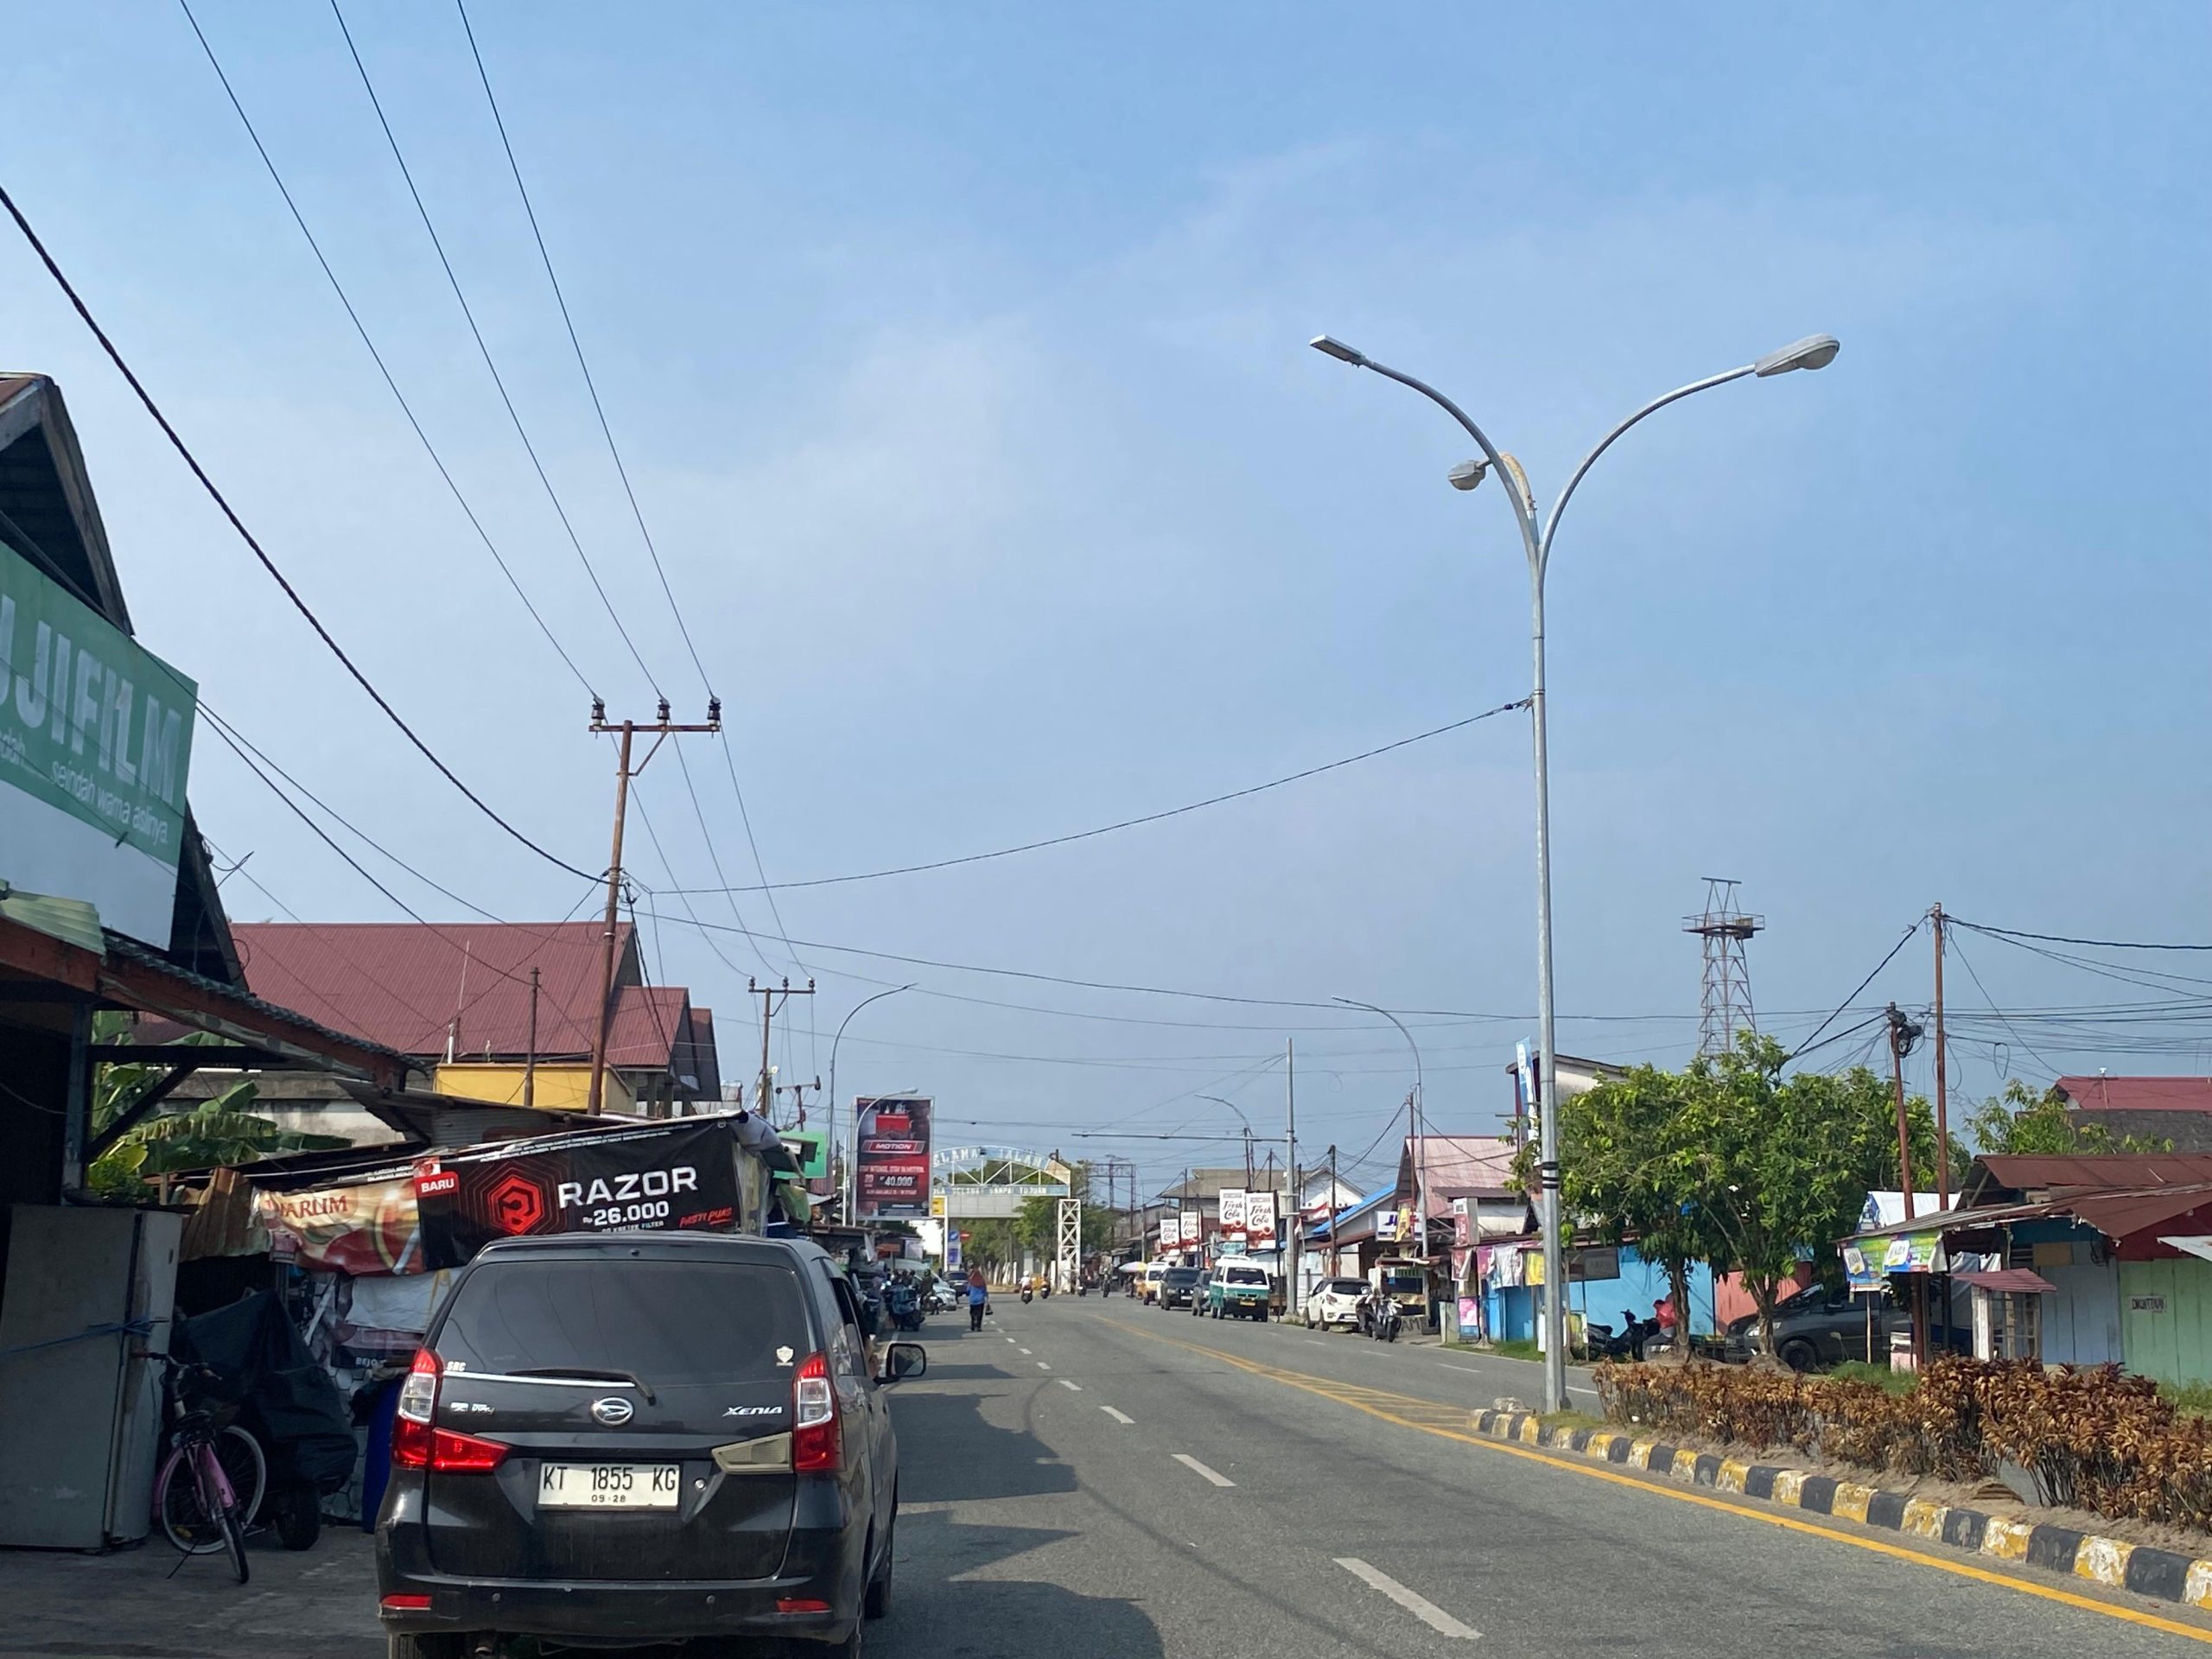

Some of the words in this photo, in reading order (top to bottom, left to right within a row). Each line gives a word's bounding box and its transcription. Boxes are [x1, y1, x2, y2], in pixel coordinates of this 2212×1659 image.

[421, 1178, 455, 1193] BARU
[557, 1166, 699, 1209] RAZOR
[1224, 1200, 1243, 1210] Fresh
[1250, 1205, 1271, 1216] Fresh
[594, 1201, 670, 1226] 26.000
[641, 1220, 664, 1230] FILTER
[543, 1466, 568, 1491] KT
[591, 1466, 633, 1491] 1855
[652, 1466, 677, 1491] KG
